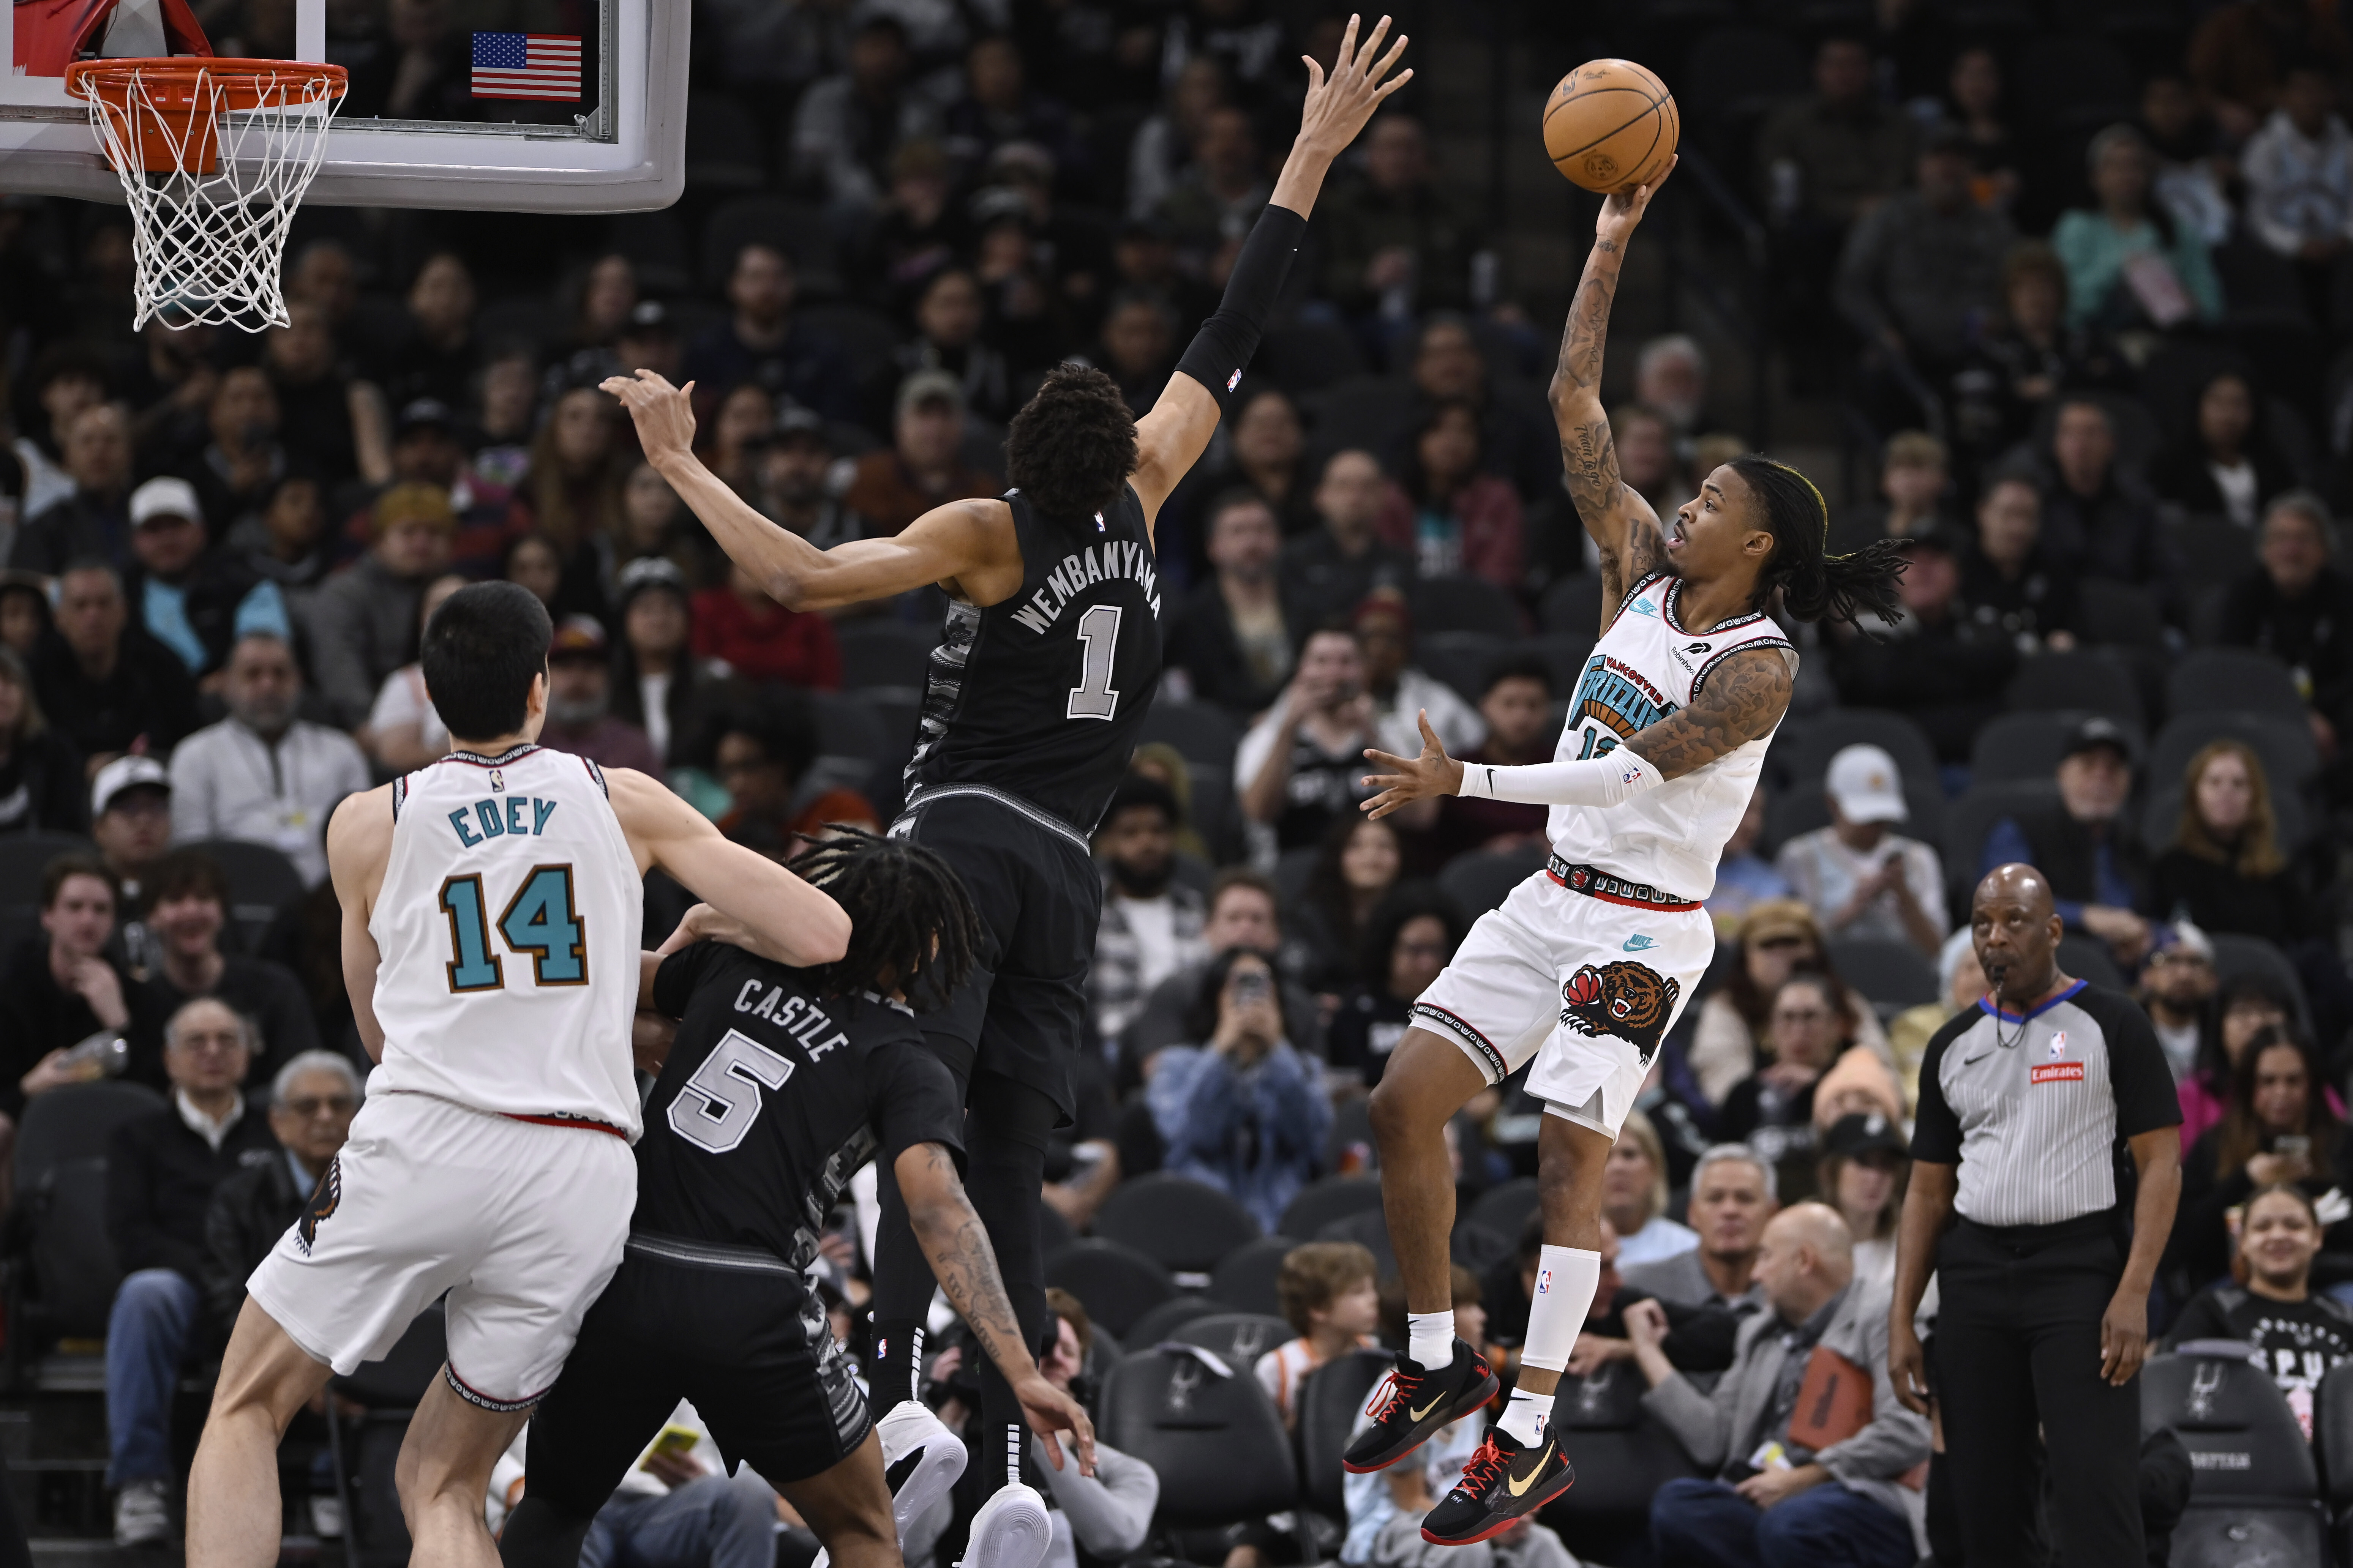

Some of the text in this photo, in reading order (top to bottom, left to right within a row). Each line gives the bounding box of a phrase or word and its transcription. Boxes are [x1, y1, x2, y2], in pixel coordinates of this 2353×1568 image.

[1010, 540, 1161, 634] WEMBANYAMA
[1635, 597, 1658, 613] NIKE
[1066, 605, 1122, 721] 1
[1568, 654, 1680, 731] GRIZZLIE
[1607, 656, 1664, 706] VANCOUVER
[1671, 646, 1697, 675] Robinhood
[448, 797, 557, 848] EDEY
[438, 863, 589, 994] 14
[1628, 934, 1653, 947] NIKE
[734, 979, 849, 1063] CASTLE
[666, 1028, 796, 1154] 5
[2032, 1066, 2083, 1080] Emirates
